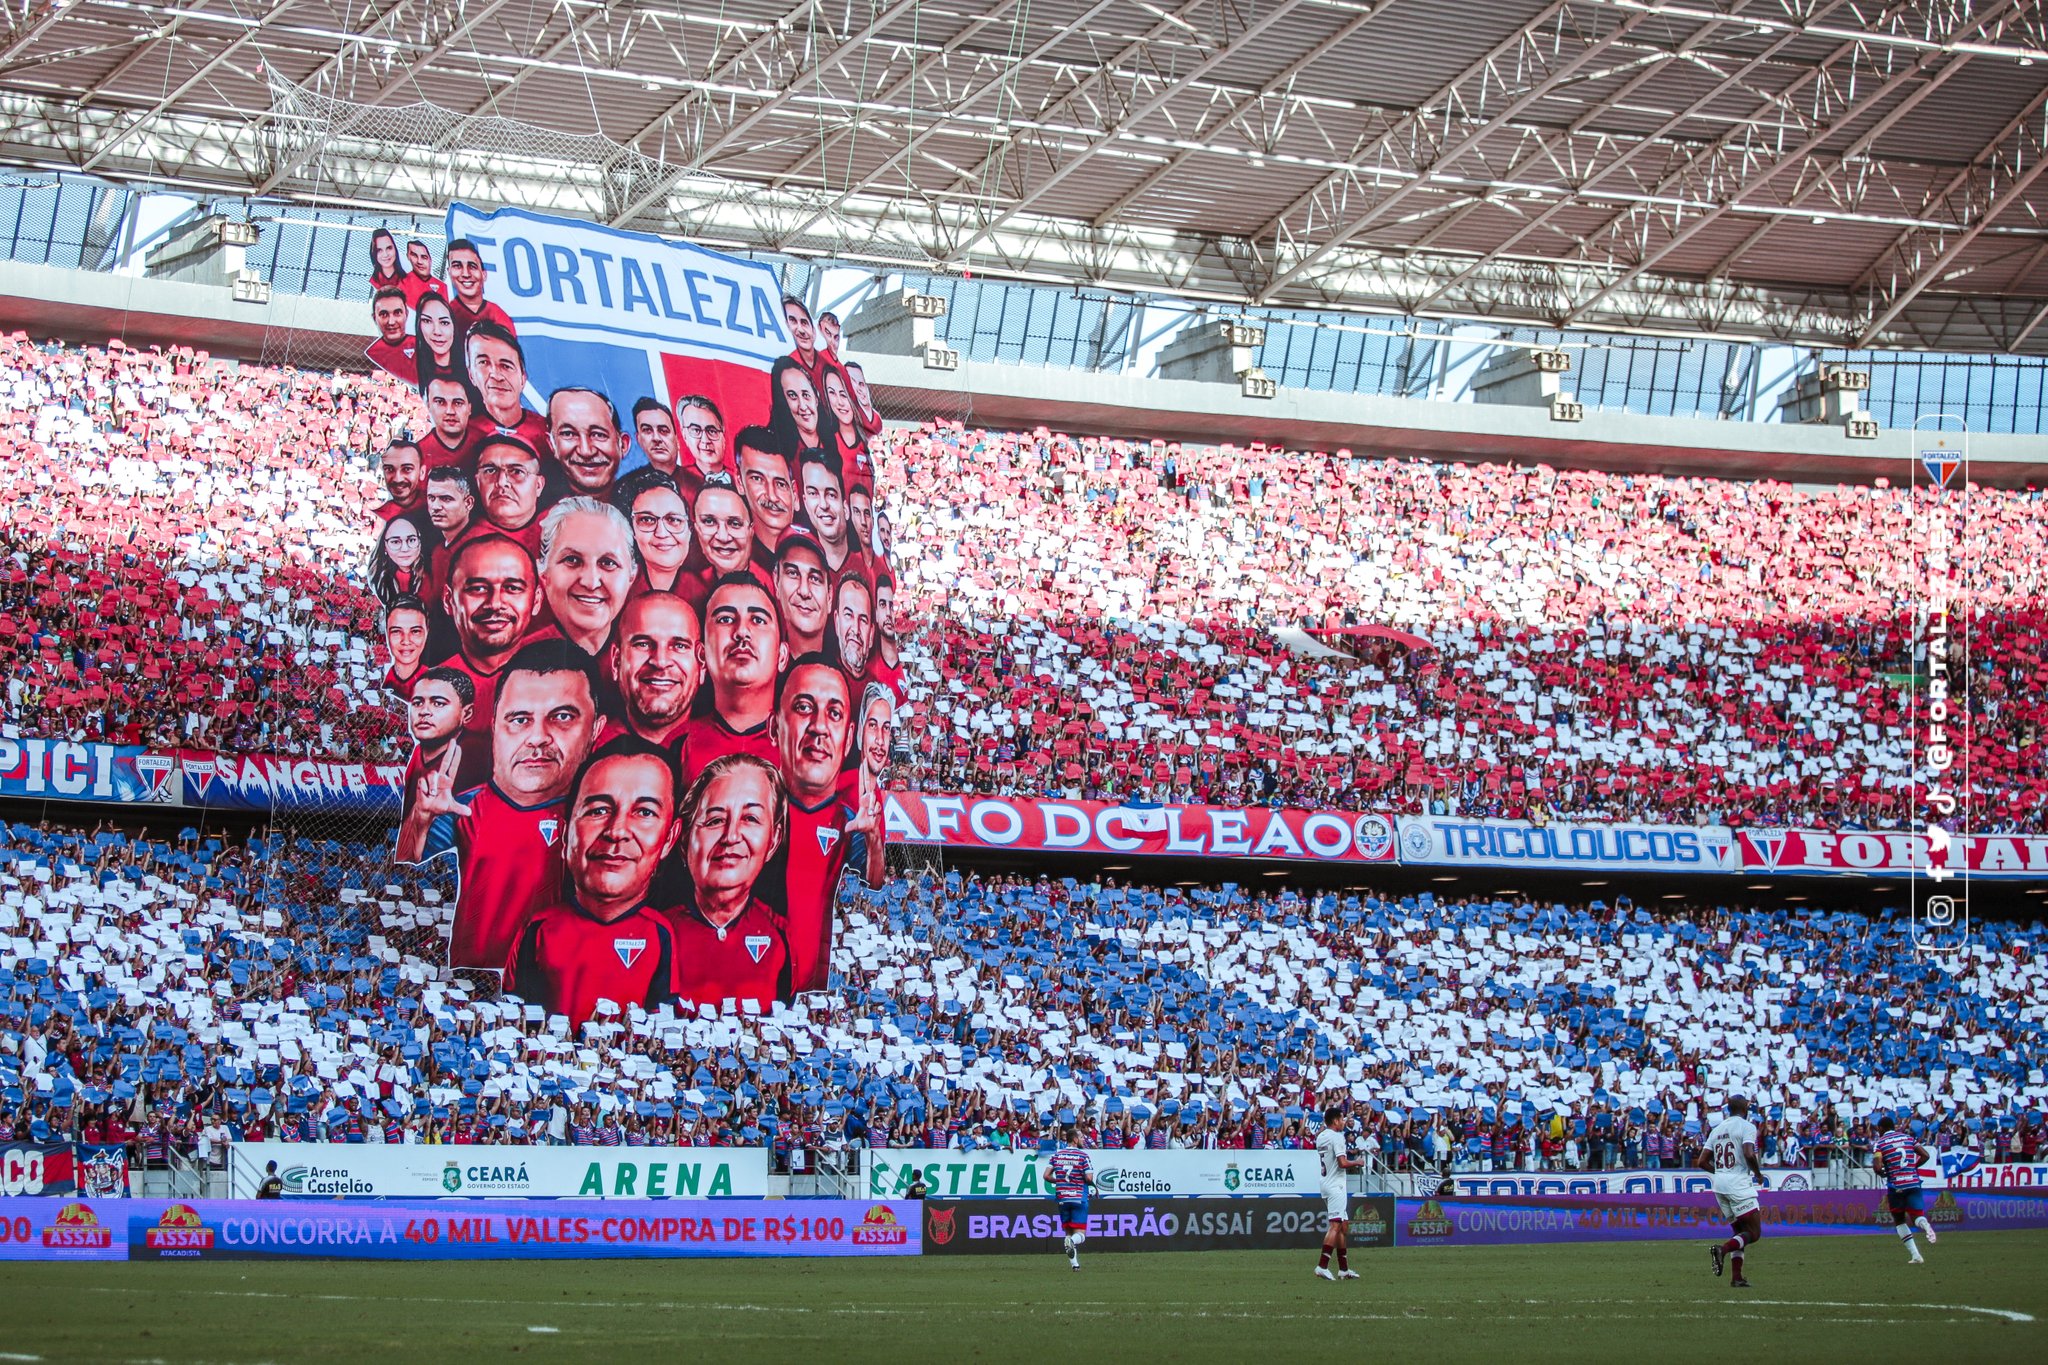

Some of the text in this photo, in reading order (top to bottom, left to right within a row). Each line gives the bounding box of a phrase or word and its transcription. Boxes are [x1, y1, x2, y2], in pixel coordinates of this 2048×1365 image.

[465, 233, 787, 343] FORTALEZA
[138, 758, 171, 767] FORTALEZA
[185, 762, 213, 771] FORTALEZA
[215, 756, 367, 804] SANGUE
[1432, 822, 1700, 863] TRICOLOUCOS
[1748, 829, 1782, 838] FORTALEZA
[615, 940, 646, 948] FORTALEZA
[1715, 1142, 1736, 1169] 26
[1895, 1147, 1909, 1167] 2
[310, 1166, 348, 1178] Arena
[467, 1161, 529, 1182] CEARÁ
[579, 1162, 733, 1195] ARENA
[1062, 1165, 1074, 1183] 7
[1120, 1169, 1151, 1179] Arena
[1244, 1163, 1295, 1181] CEARÁ
[308, 1178, 373, 1193] Castelão
[1119, 1179, 1171, 1192] Castelão
[1458, 1210, 1558, 1232] CONCORRA
[1563, 1209, 1575, 1230] A
[1578, 1208, 1602, 1230] 40
[1607, 1207, 1642, 1229] MIL
[1785, 1204, 1808, 1224] DE
[1812, 1202, 1867, 1224] R$100
[1967, 1199, 2046, 1219] CONCORRA
[222, 1214, 844, 1245] CONCORRA A 40 MIL VALES-COMPRA DE R$100
[968, 1206, 1329, 1239] BRASIEIRÃO ASSAÍ 2023
